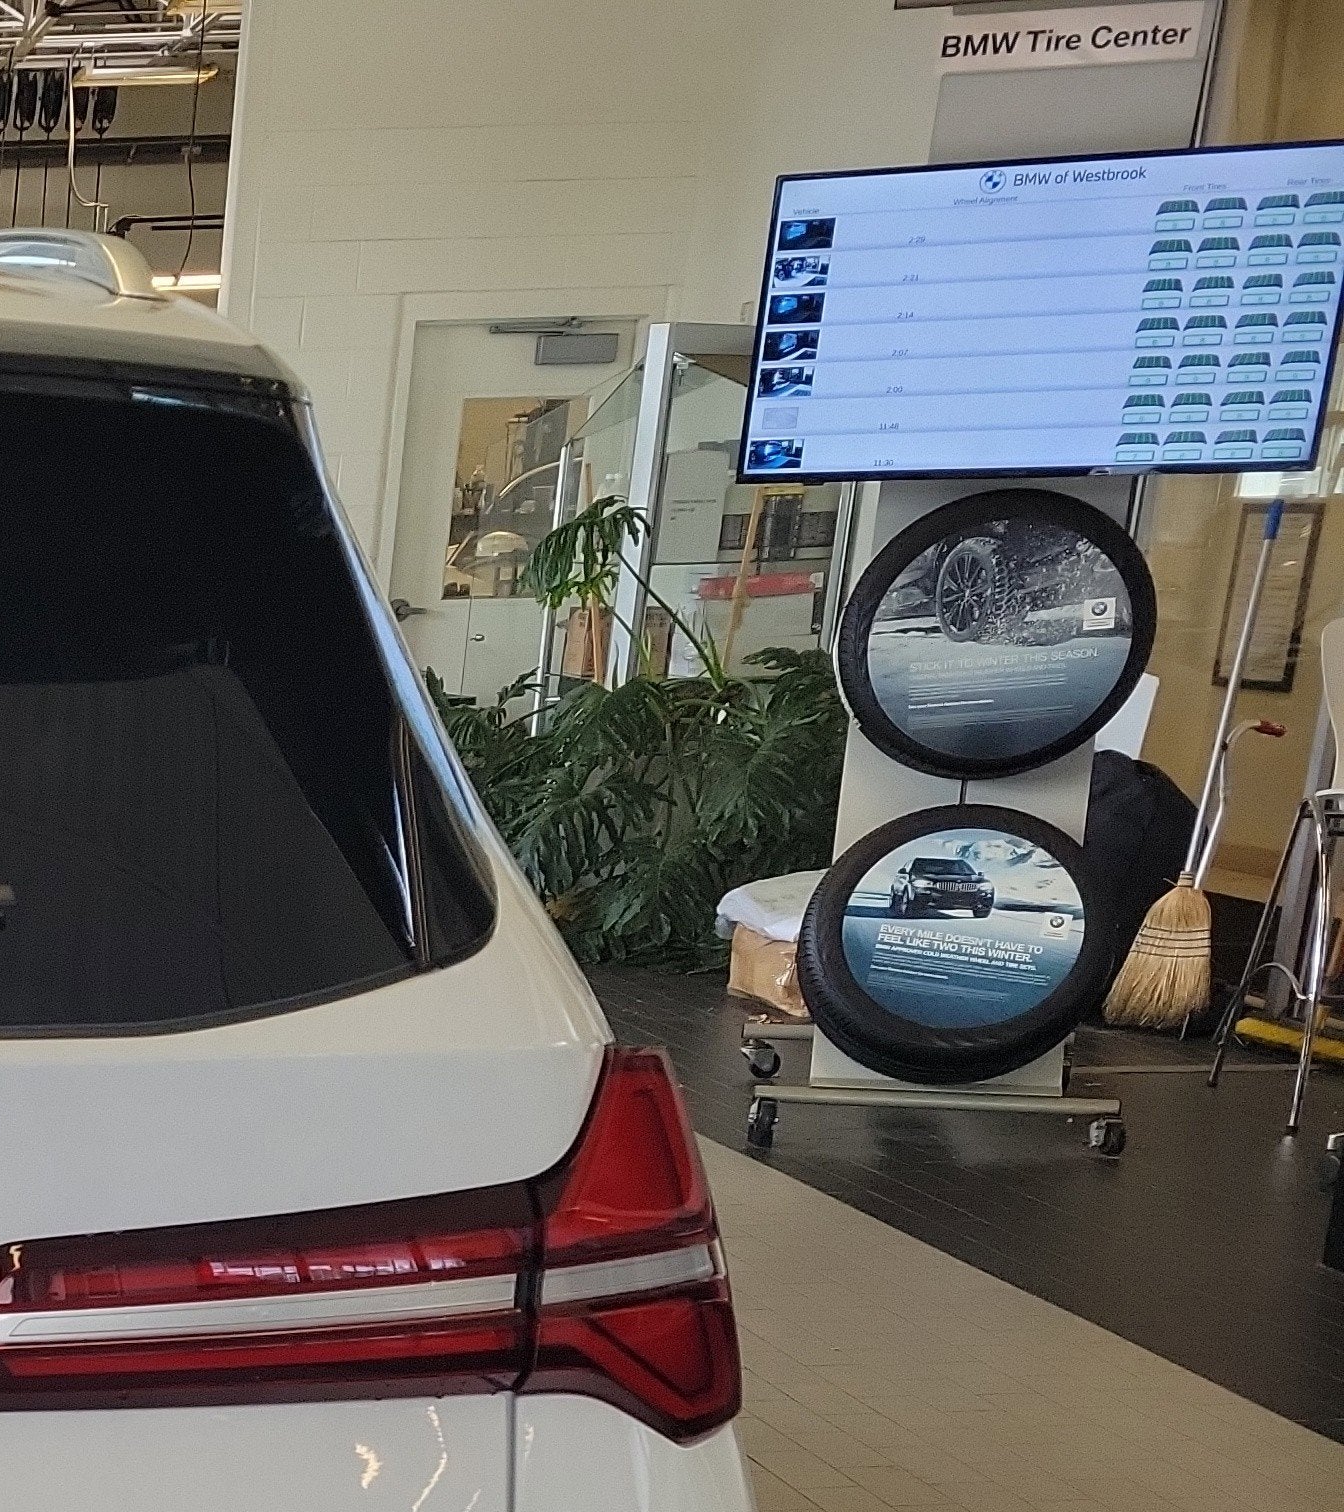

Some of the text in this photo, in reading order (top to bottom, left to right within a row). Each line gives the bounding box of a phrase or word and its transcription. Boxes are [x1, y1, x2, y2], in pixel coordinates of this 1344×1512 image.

[941, 26, 1192, 58] BMW Tire Center
[1014, 166, 1147, 187] BMW of Westbrook
[793, 207, 820, 216] Vehicle
[1024, 652, 1048, 662] THIS
[877, 933, 1033, 962] FEEL LIKE TWO THIS WINTER.
[880, 924, 1043, 954] EVERY MILE DOESN'T HAVE TO
